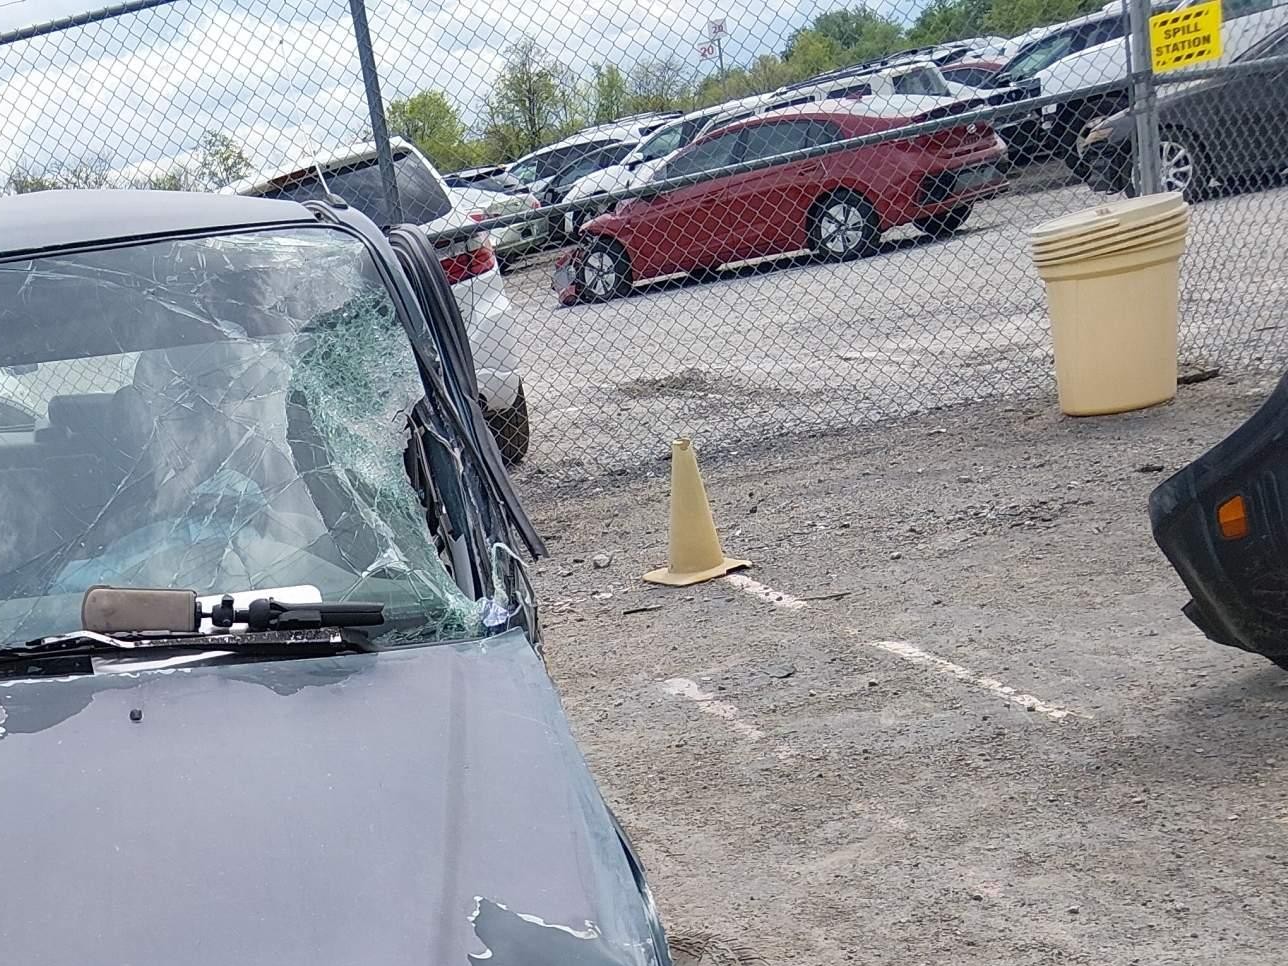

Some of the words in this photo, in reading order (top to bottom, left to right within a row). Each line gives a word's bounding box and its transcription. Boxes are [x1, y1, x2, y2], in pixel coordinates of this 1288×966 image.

[1163, 22, 1201, 39] SPILL
[700, 45, 714, 57] 20
[1155, 34, 1212, 57] STATION
